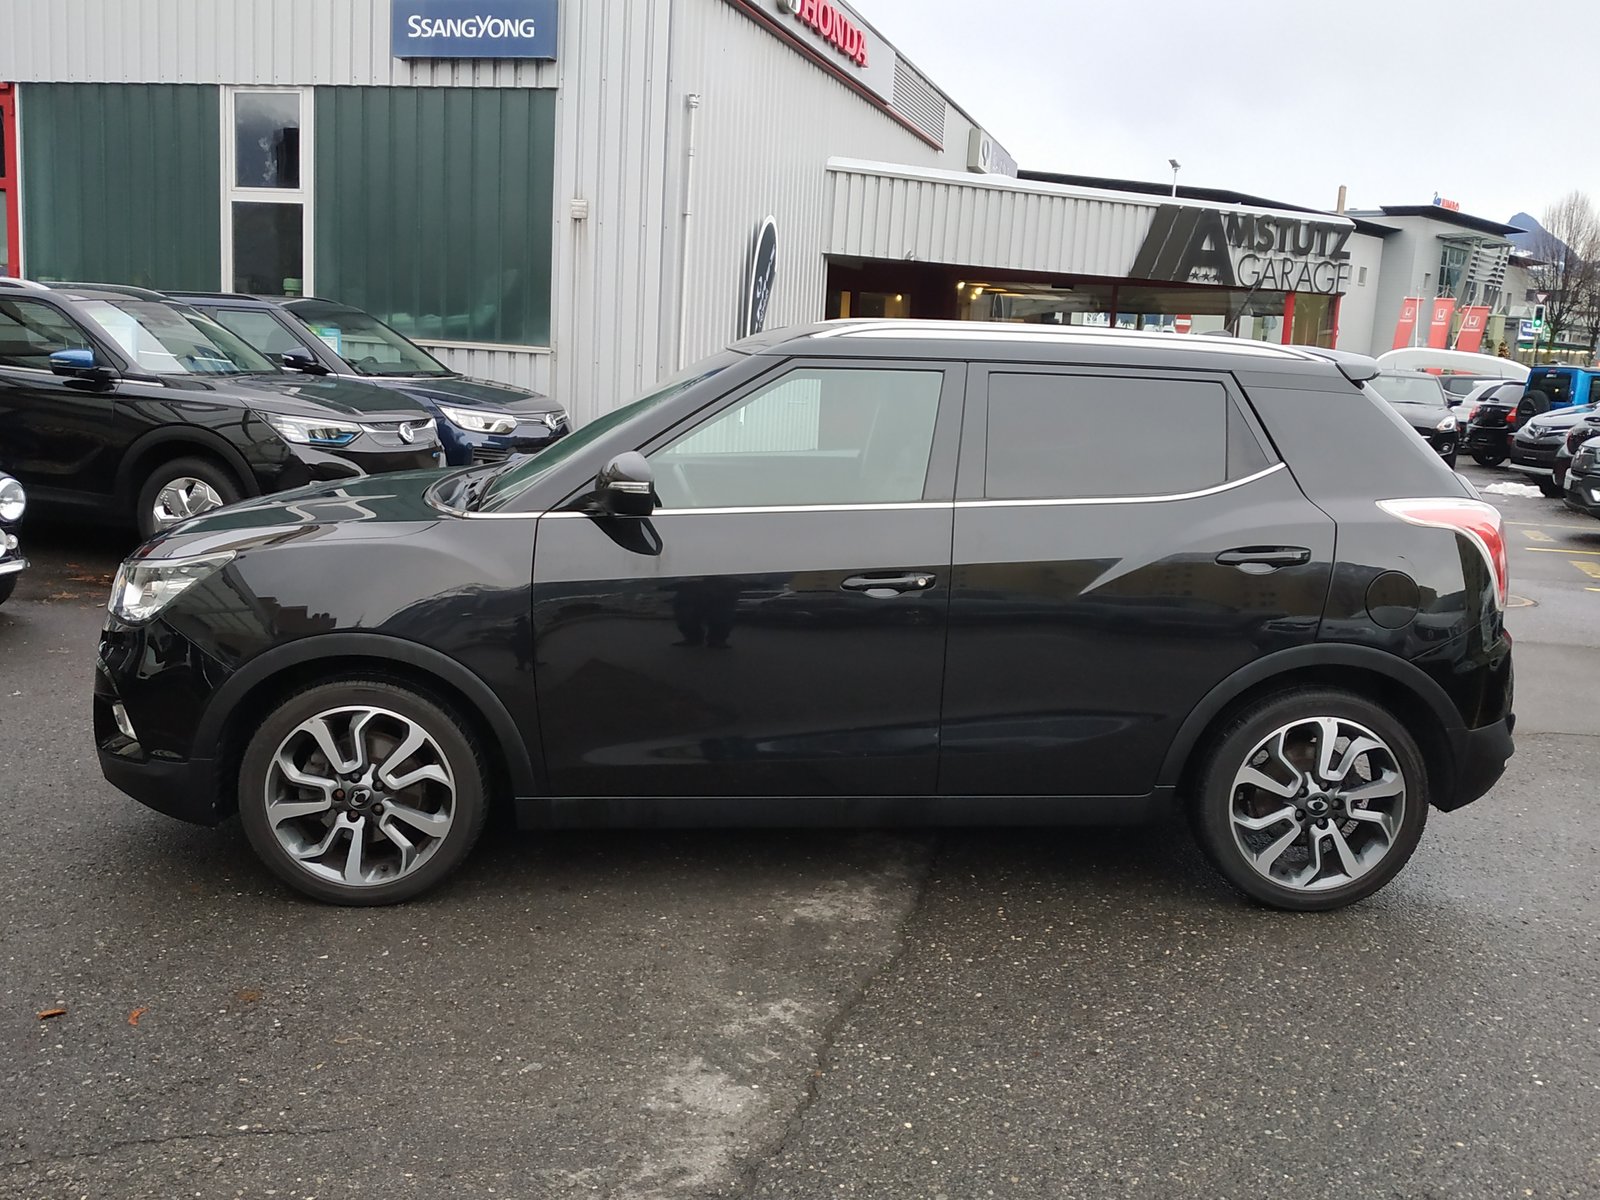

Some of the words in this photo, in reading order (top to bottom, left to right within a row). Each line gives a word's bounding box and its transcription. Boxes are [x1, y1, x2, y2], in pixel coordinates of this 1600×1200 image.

[797, 0, 868, 68] HONDA
[1171, 206, 1356, 286] AMSTUTZ
[1238, 254, 1350, 296] GARAGE
